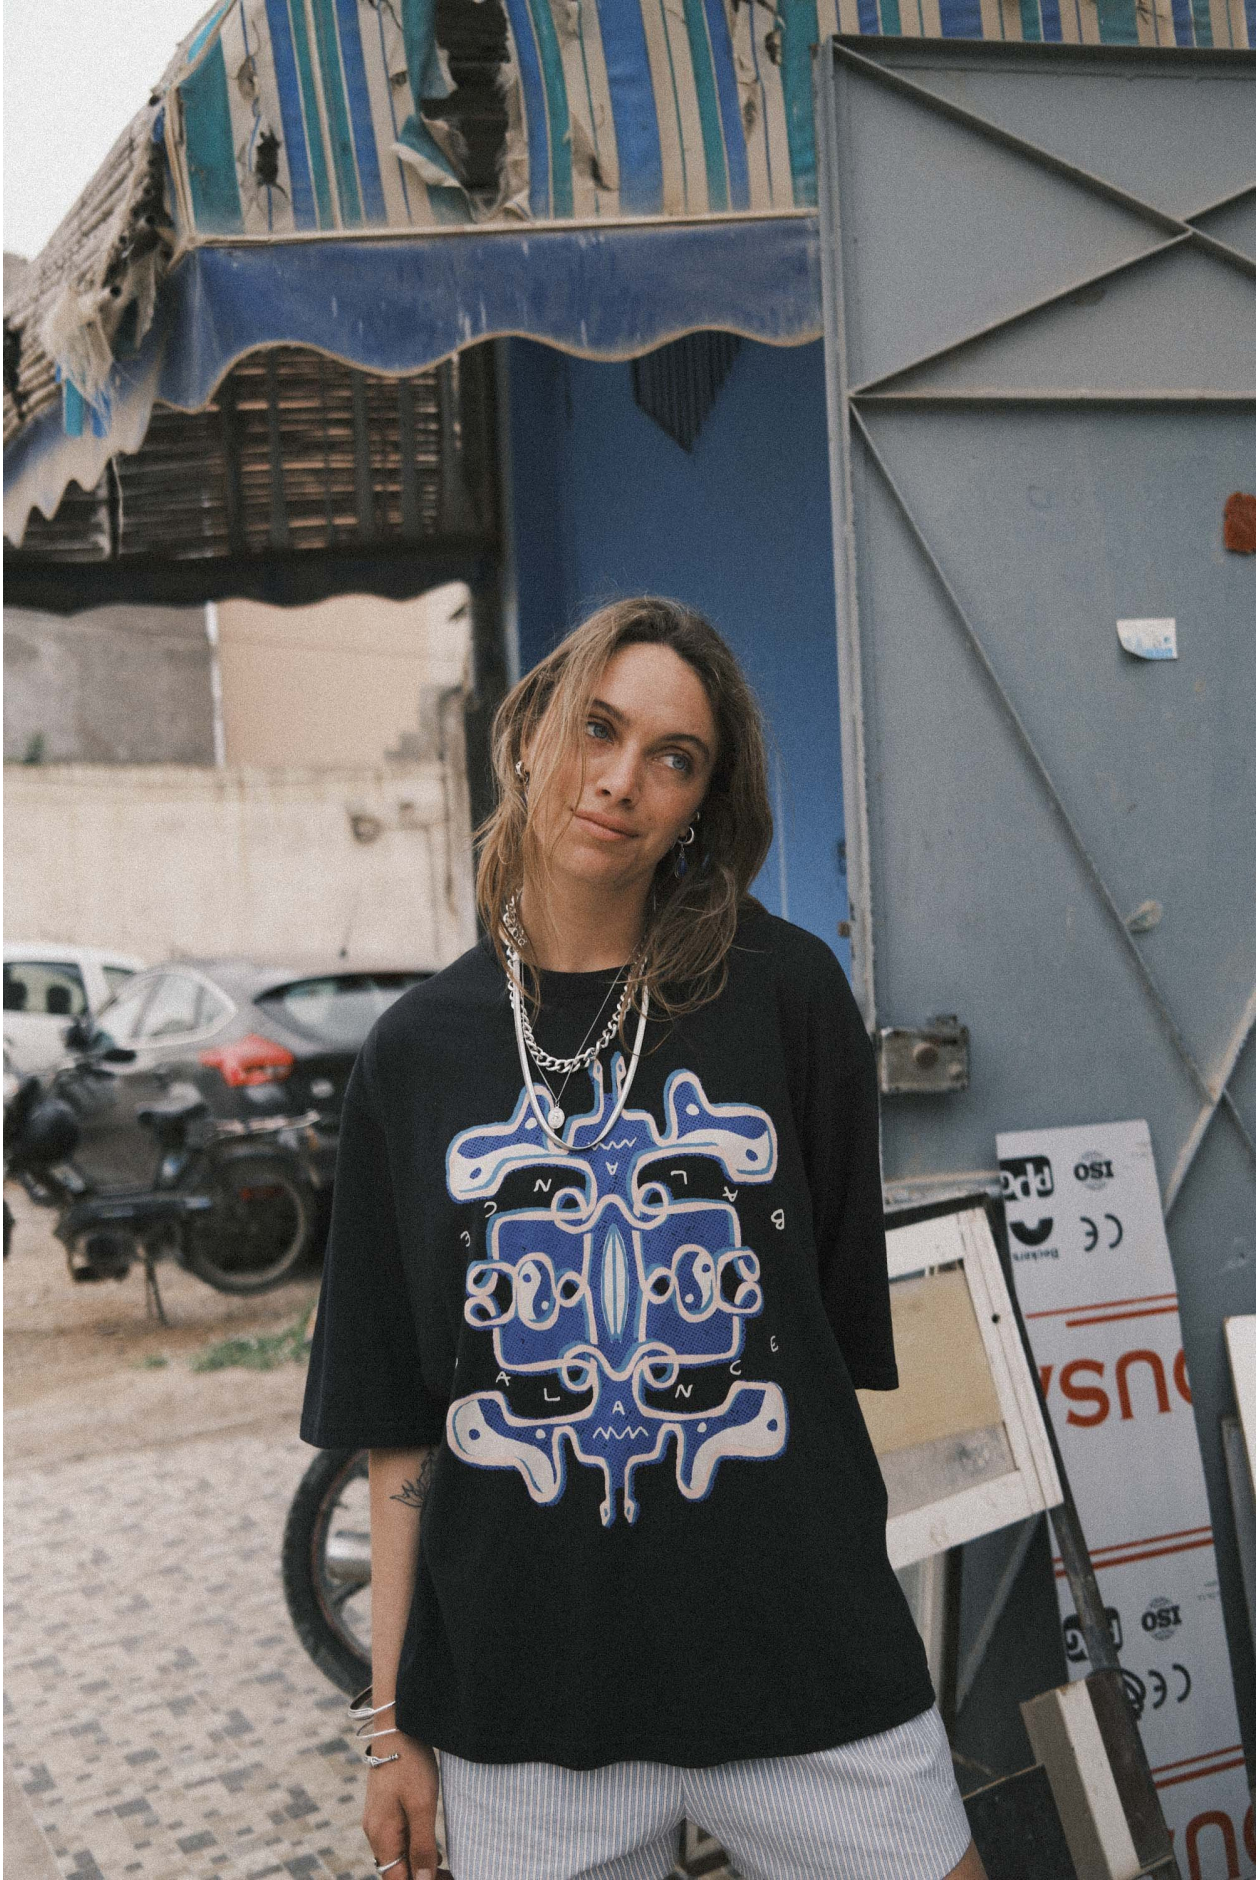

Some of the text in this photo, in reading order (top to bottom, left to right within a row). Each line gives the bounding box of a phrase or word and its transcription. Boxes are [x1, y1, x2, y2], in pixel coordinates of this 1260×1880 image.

[1073, 1160, 1115, 1182] ISO
[454, 1335, 779, 1416] ALANCE
[1141, 1604, 1182, 1632] ISO
